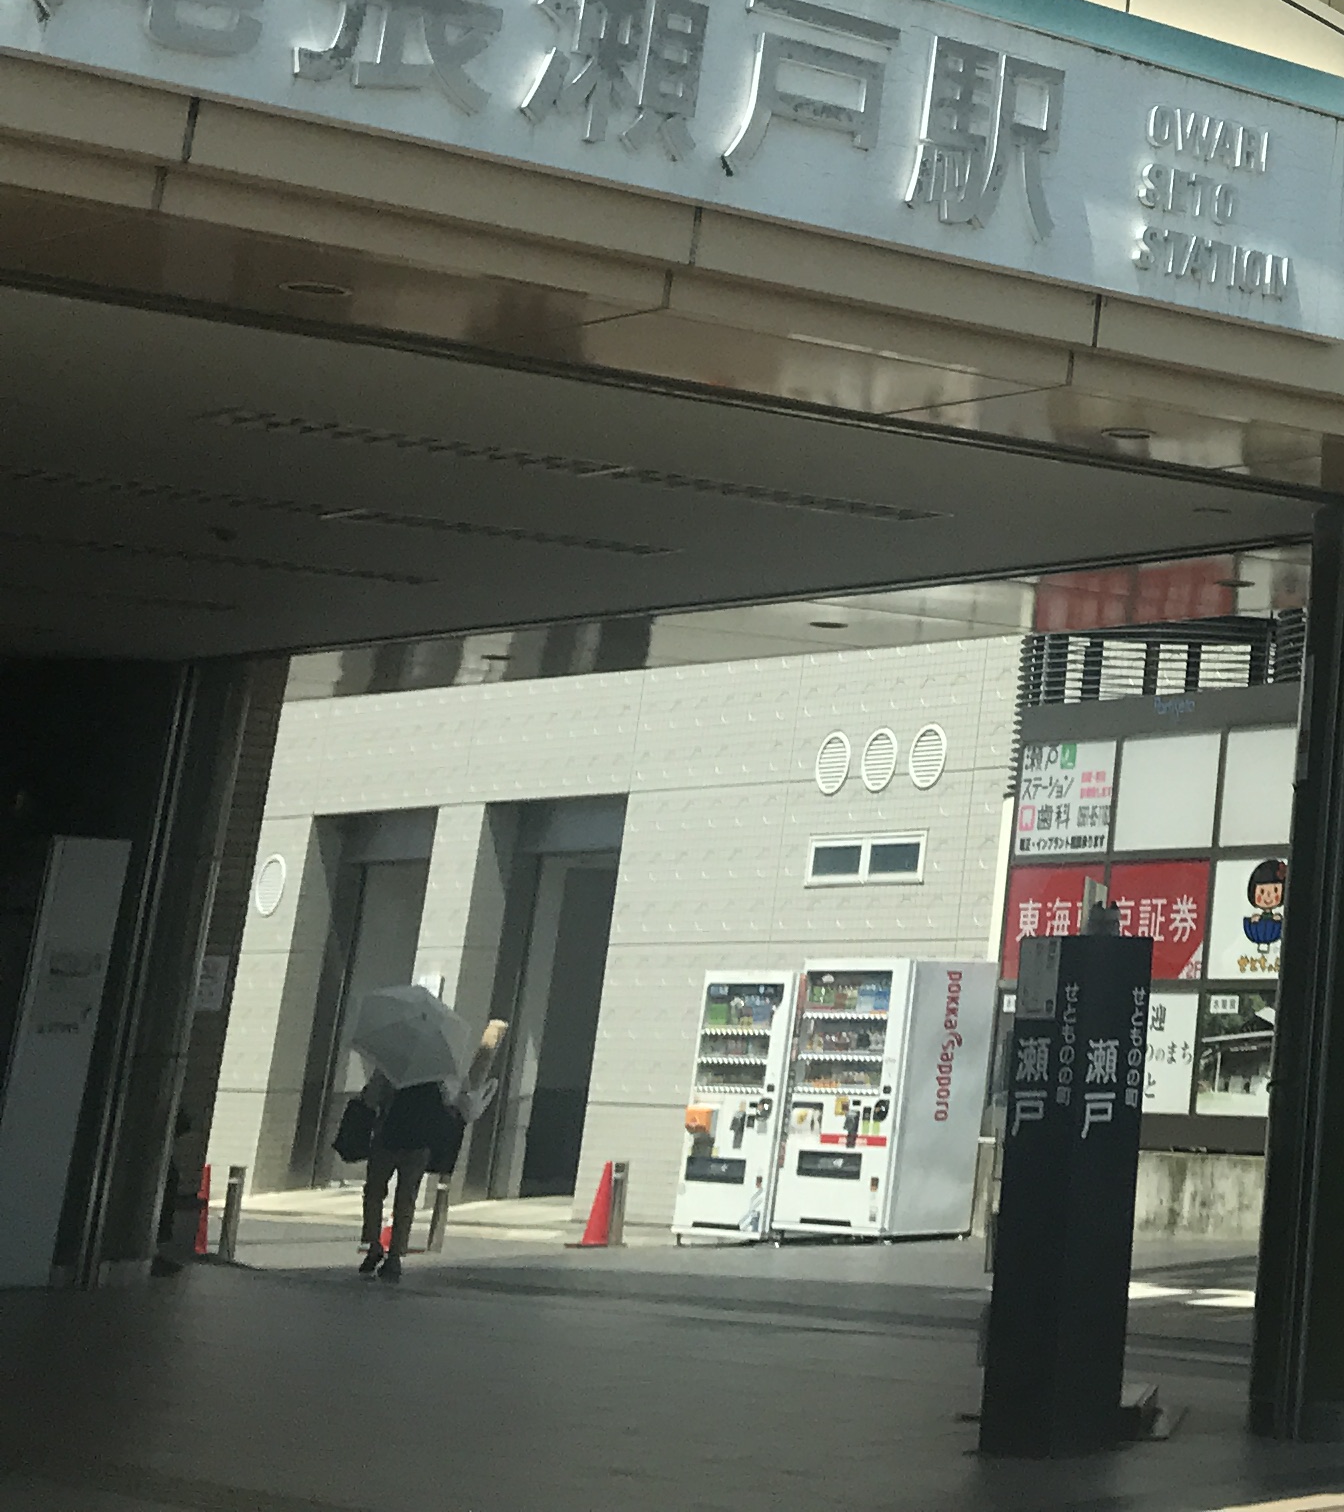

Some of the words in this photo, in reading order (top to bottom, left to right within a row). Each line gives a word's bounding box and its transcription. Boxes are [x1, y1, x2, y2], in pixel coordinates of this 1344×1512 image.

[1147, 104, 1270, 174] OWARI
[1137, 162, 1237, 226] SETO
[1131, 225, 1290, 300] STATION
[1016, 895, 1197, 942] 東海京証券
[1011, 1037, 1051, 1137] 瀬戸
[1081, 1038, 1120, 1139] 瀬戸
